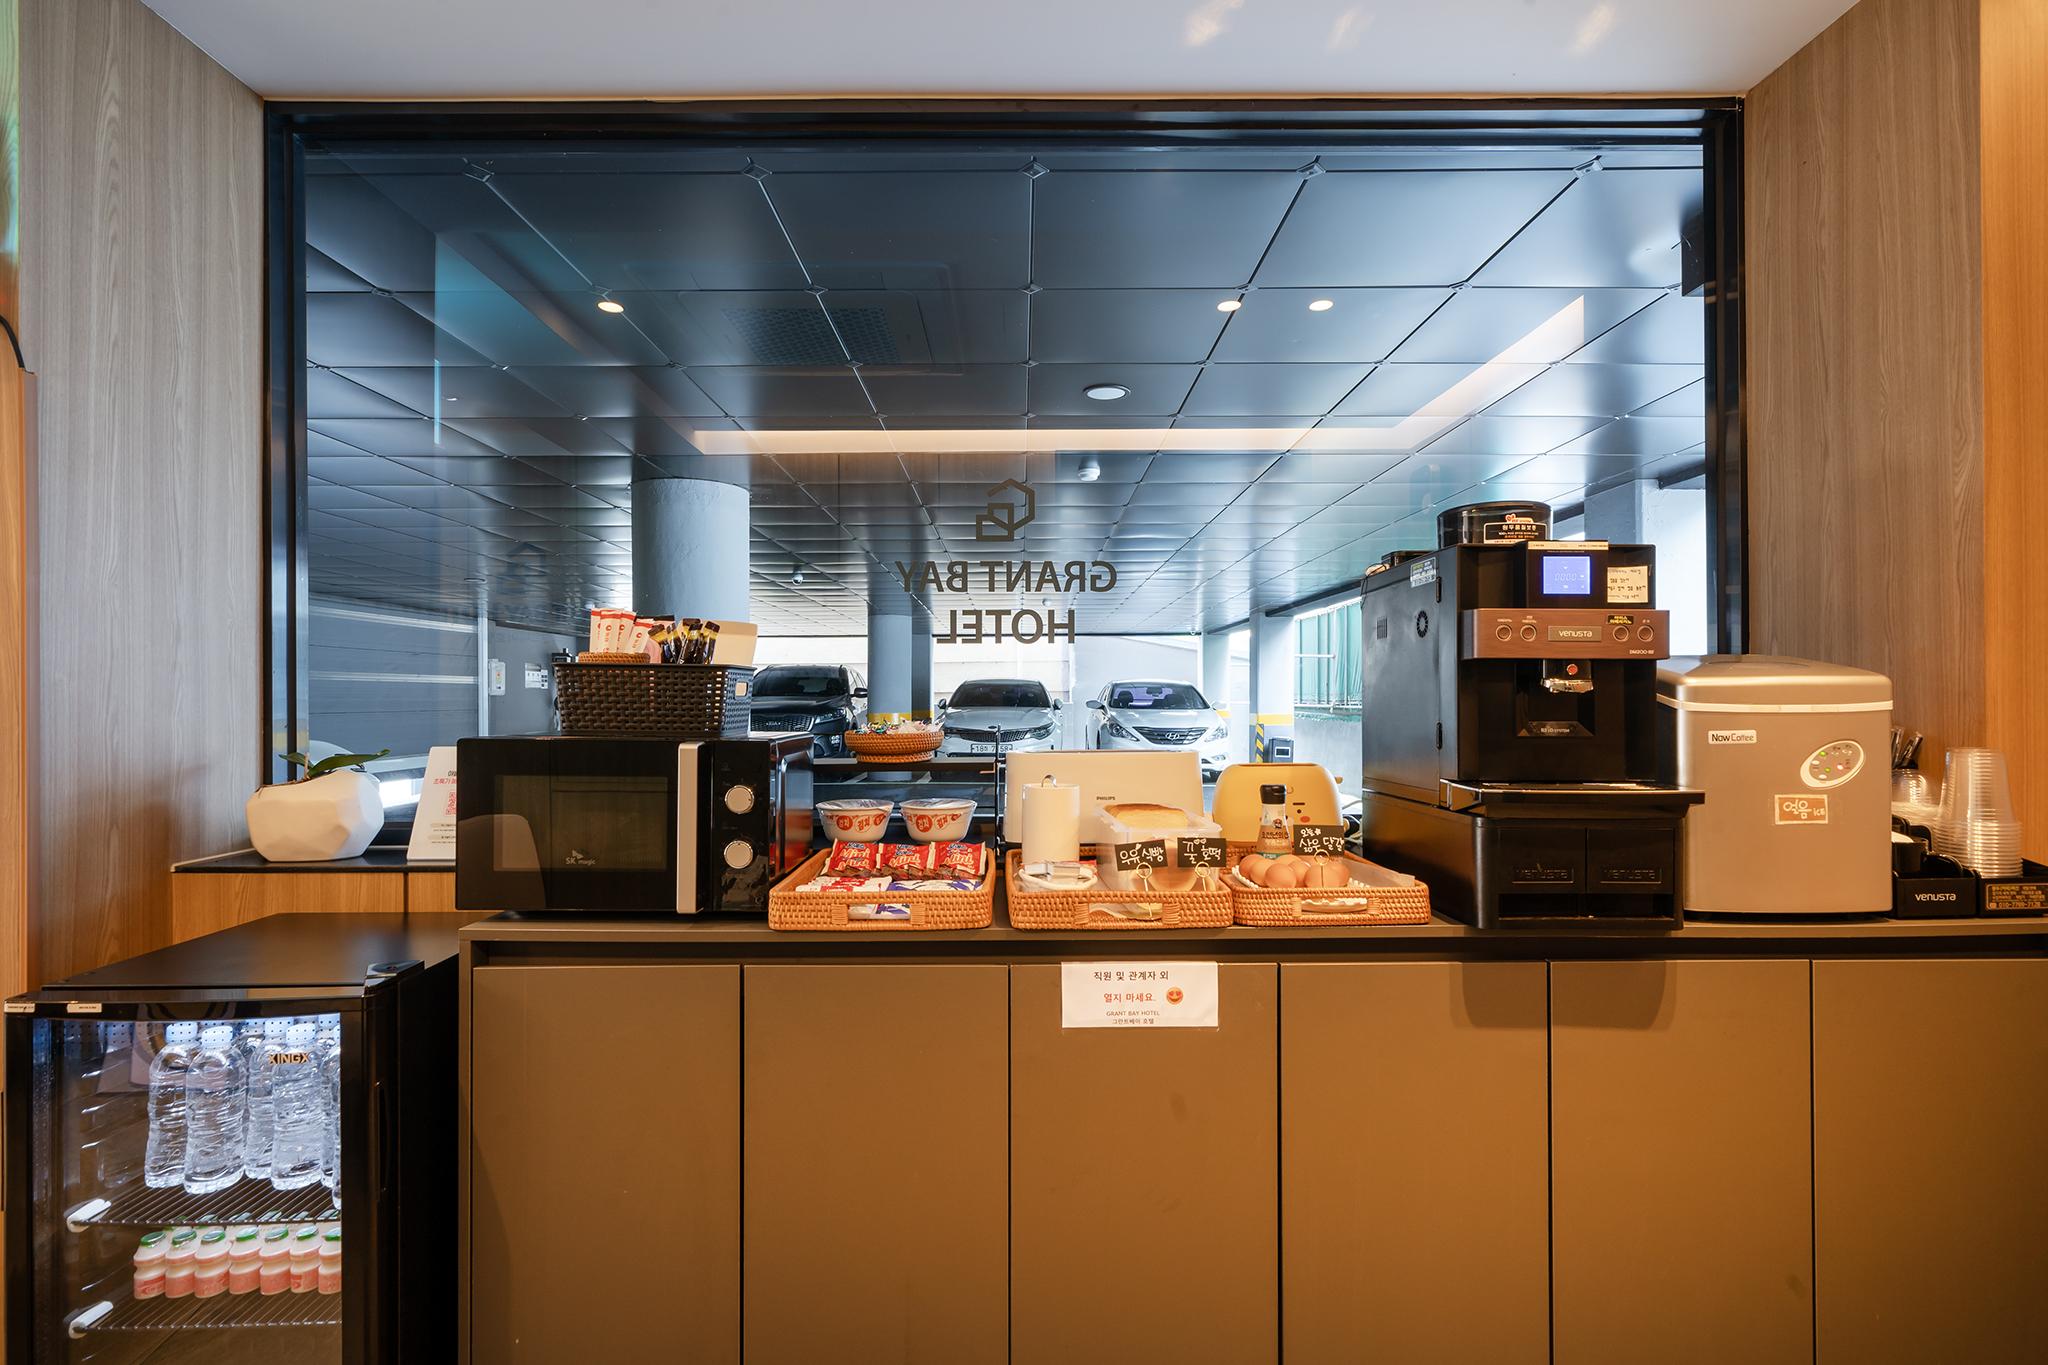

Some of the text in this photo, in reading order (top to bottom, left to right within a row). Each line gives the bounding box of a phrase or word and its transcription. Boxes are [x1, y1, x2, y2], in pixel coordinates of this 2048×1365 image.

[1783, 799, 1813, 819] 얼음
[1119, 846, 1164, 865] 우유 식빵
[1182, 840, 1198, 864] 꿀
[1093, 970, 1170, 982] 직원 및 관계자 외
[1103, 992, 1122, 1003] 열지
